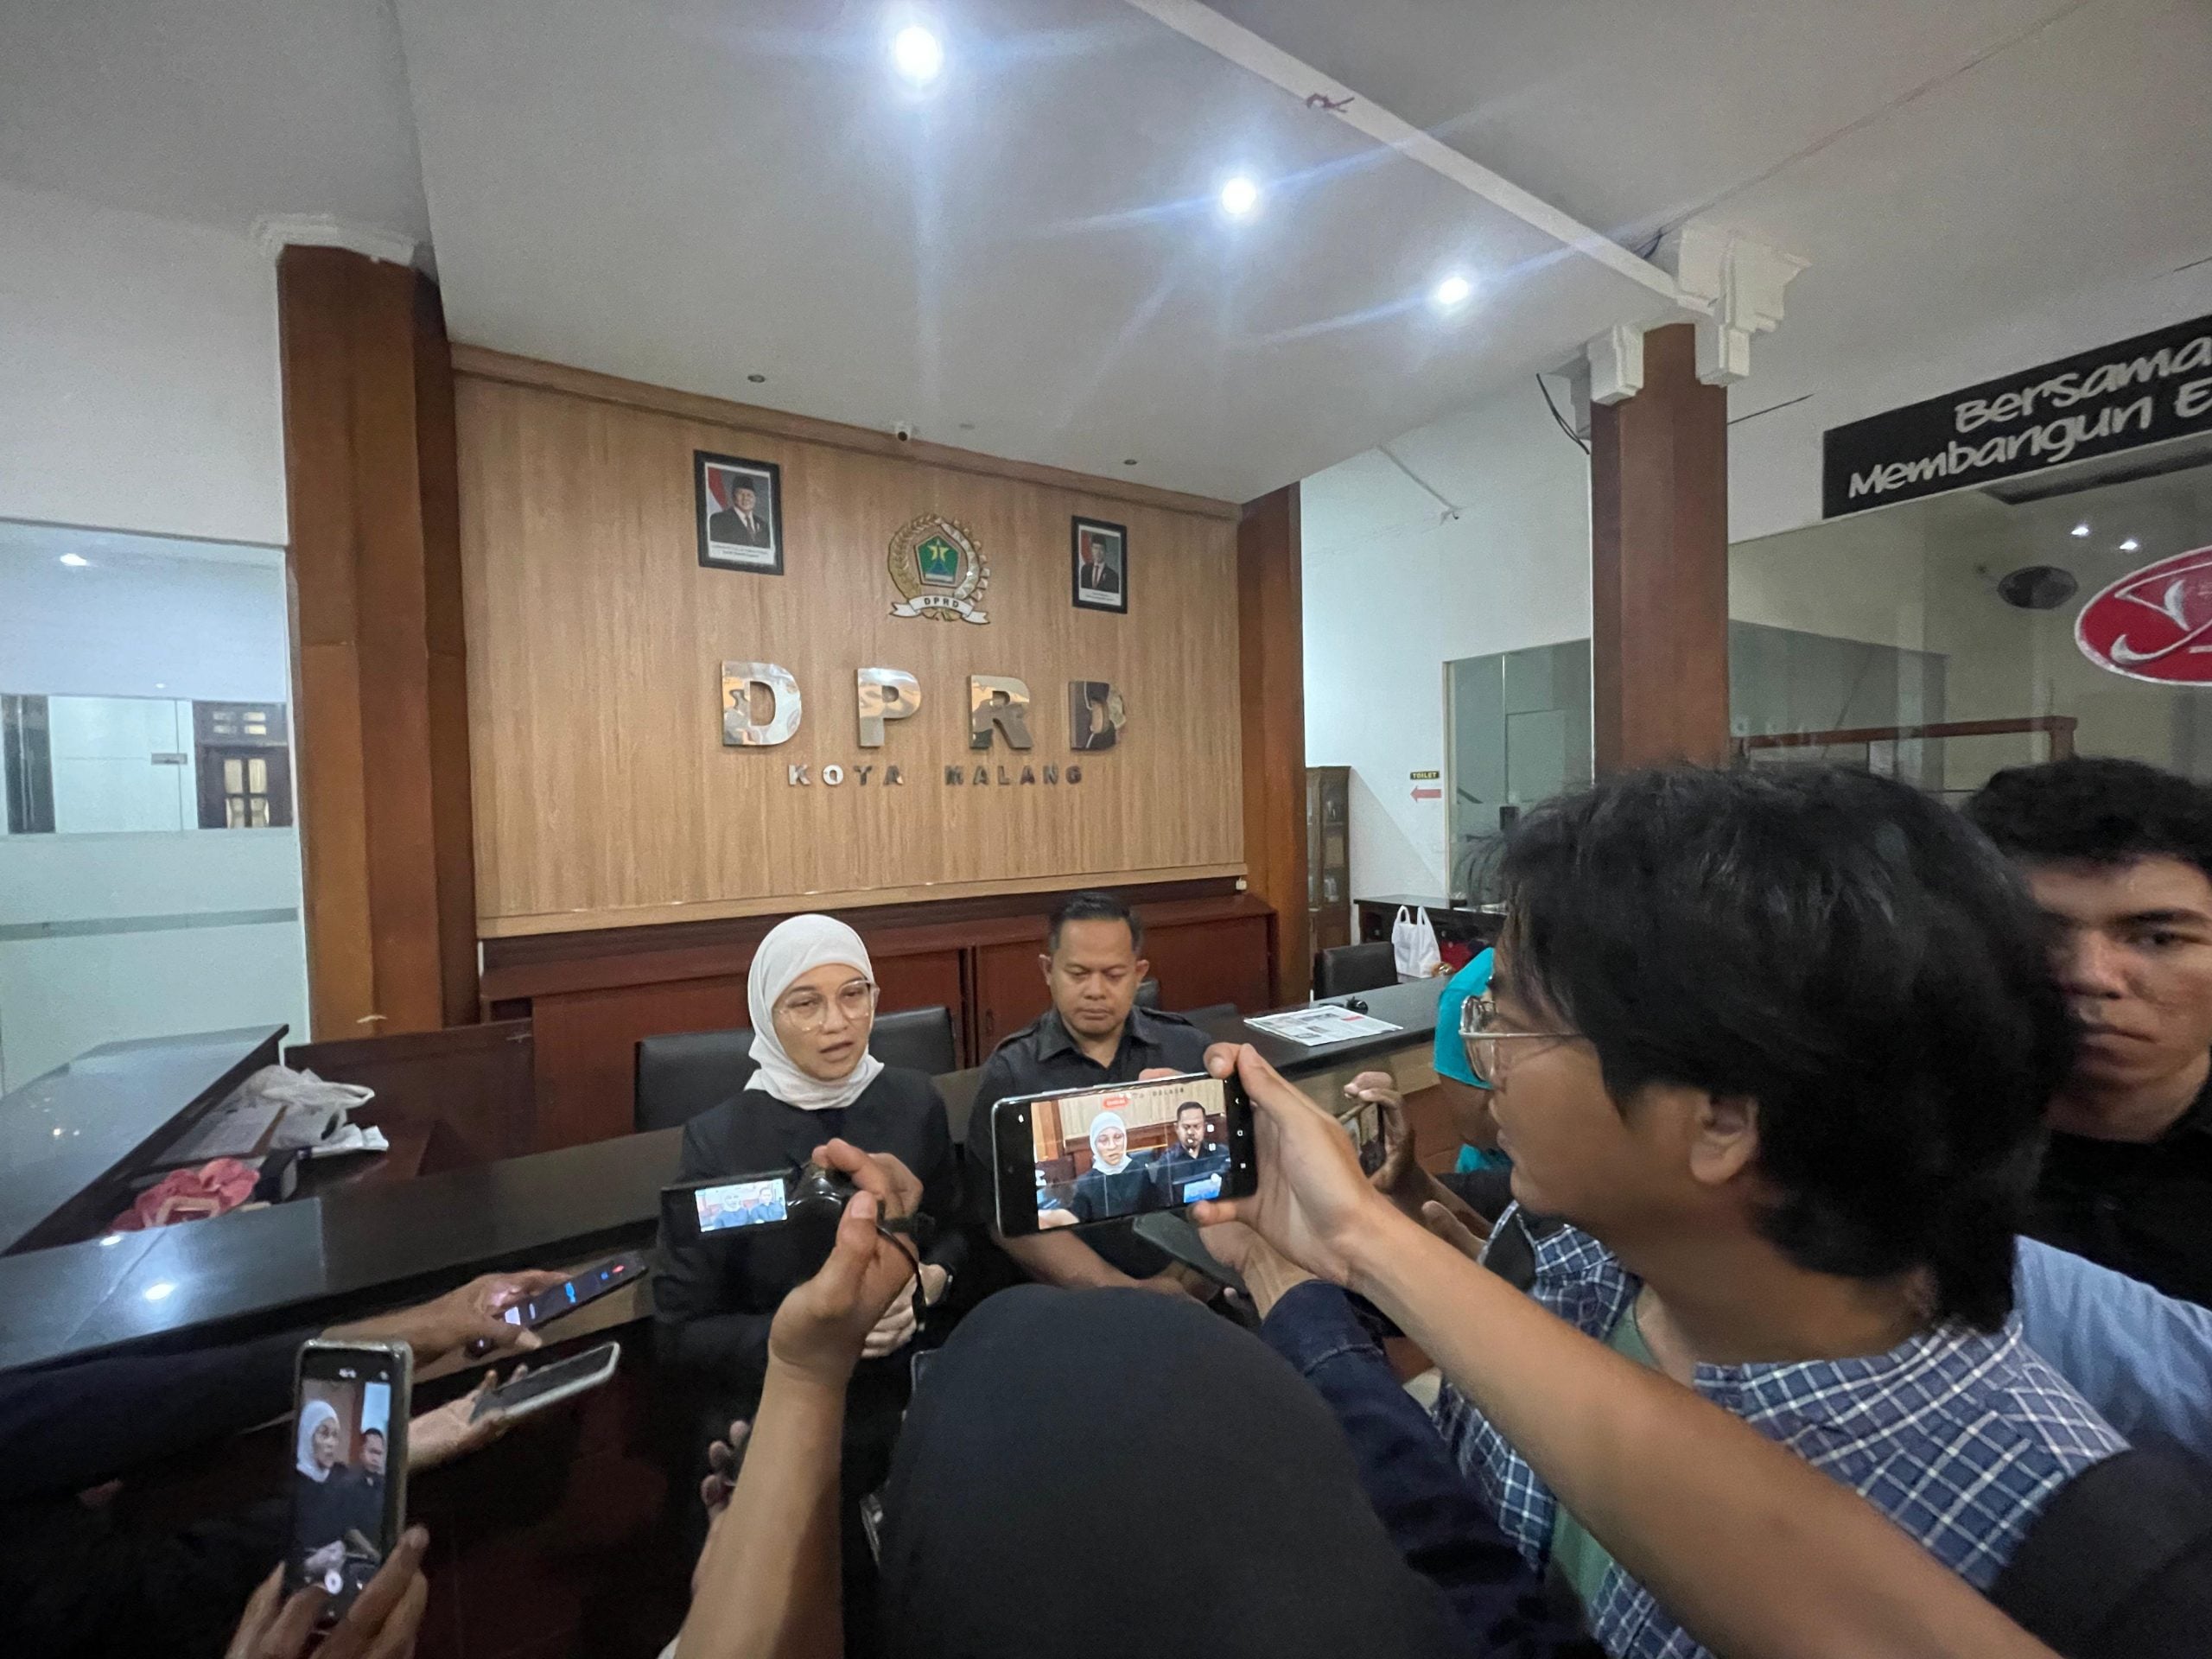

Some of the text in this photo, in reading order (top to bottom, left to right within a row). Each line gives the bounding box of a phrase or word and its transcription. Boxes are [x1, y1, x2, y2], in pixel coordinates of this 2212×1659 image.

[1955, 336, 2212, 433] Bersama
[1849, 396, 2153, 499] Membangun
[924, 597, 959, 608] DPRD
[721, 659, 1127, 750] DPRD
[944, 764, 1082, 785] MALANG
